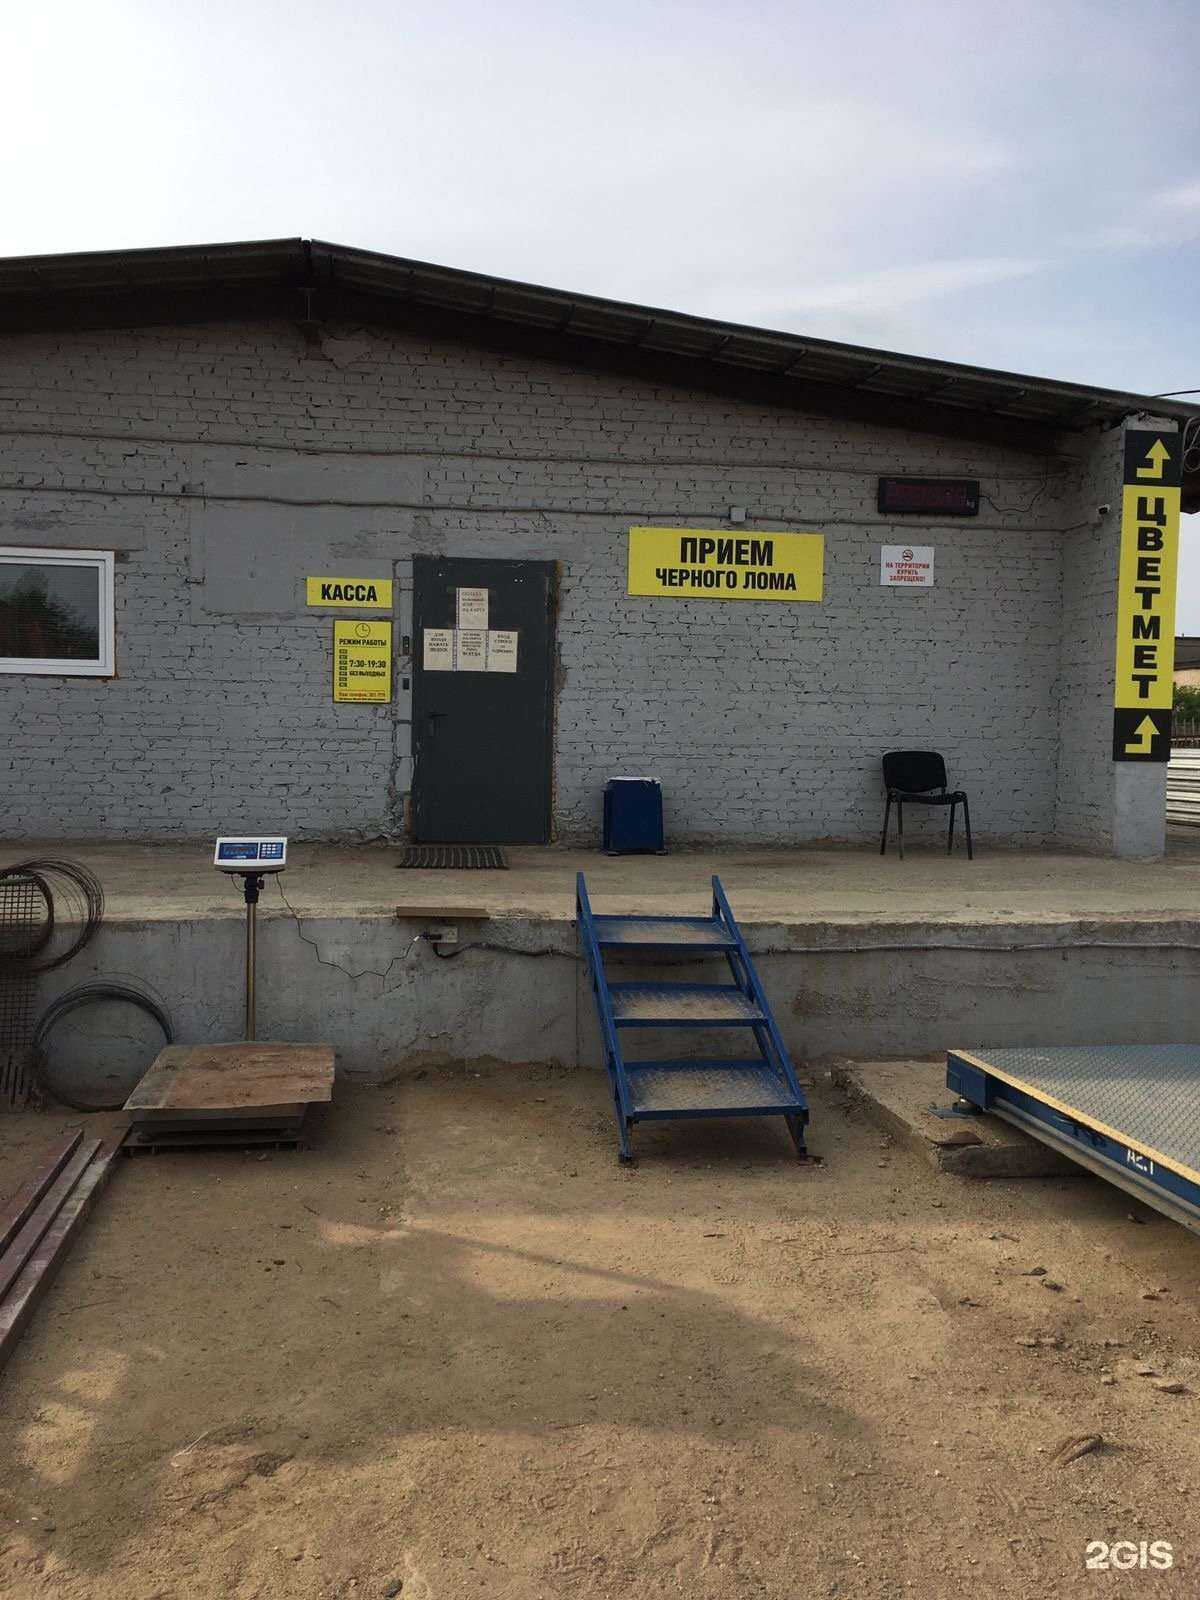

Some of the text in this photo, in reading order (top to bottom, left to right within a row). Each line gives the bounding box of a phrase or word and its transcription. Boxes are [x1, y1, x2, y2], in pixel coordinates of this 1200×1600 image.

[680, 537, 774, 567] ПРИЕМ
[321, 583, 377, 602] КАССА
[655, 568, 797, 591] ЧЕРНОГО ЛОМА
[1131, 496, 1167, 699] ЦВЕТМЕТ
